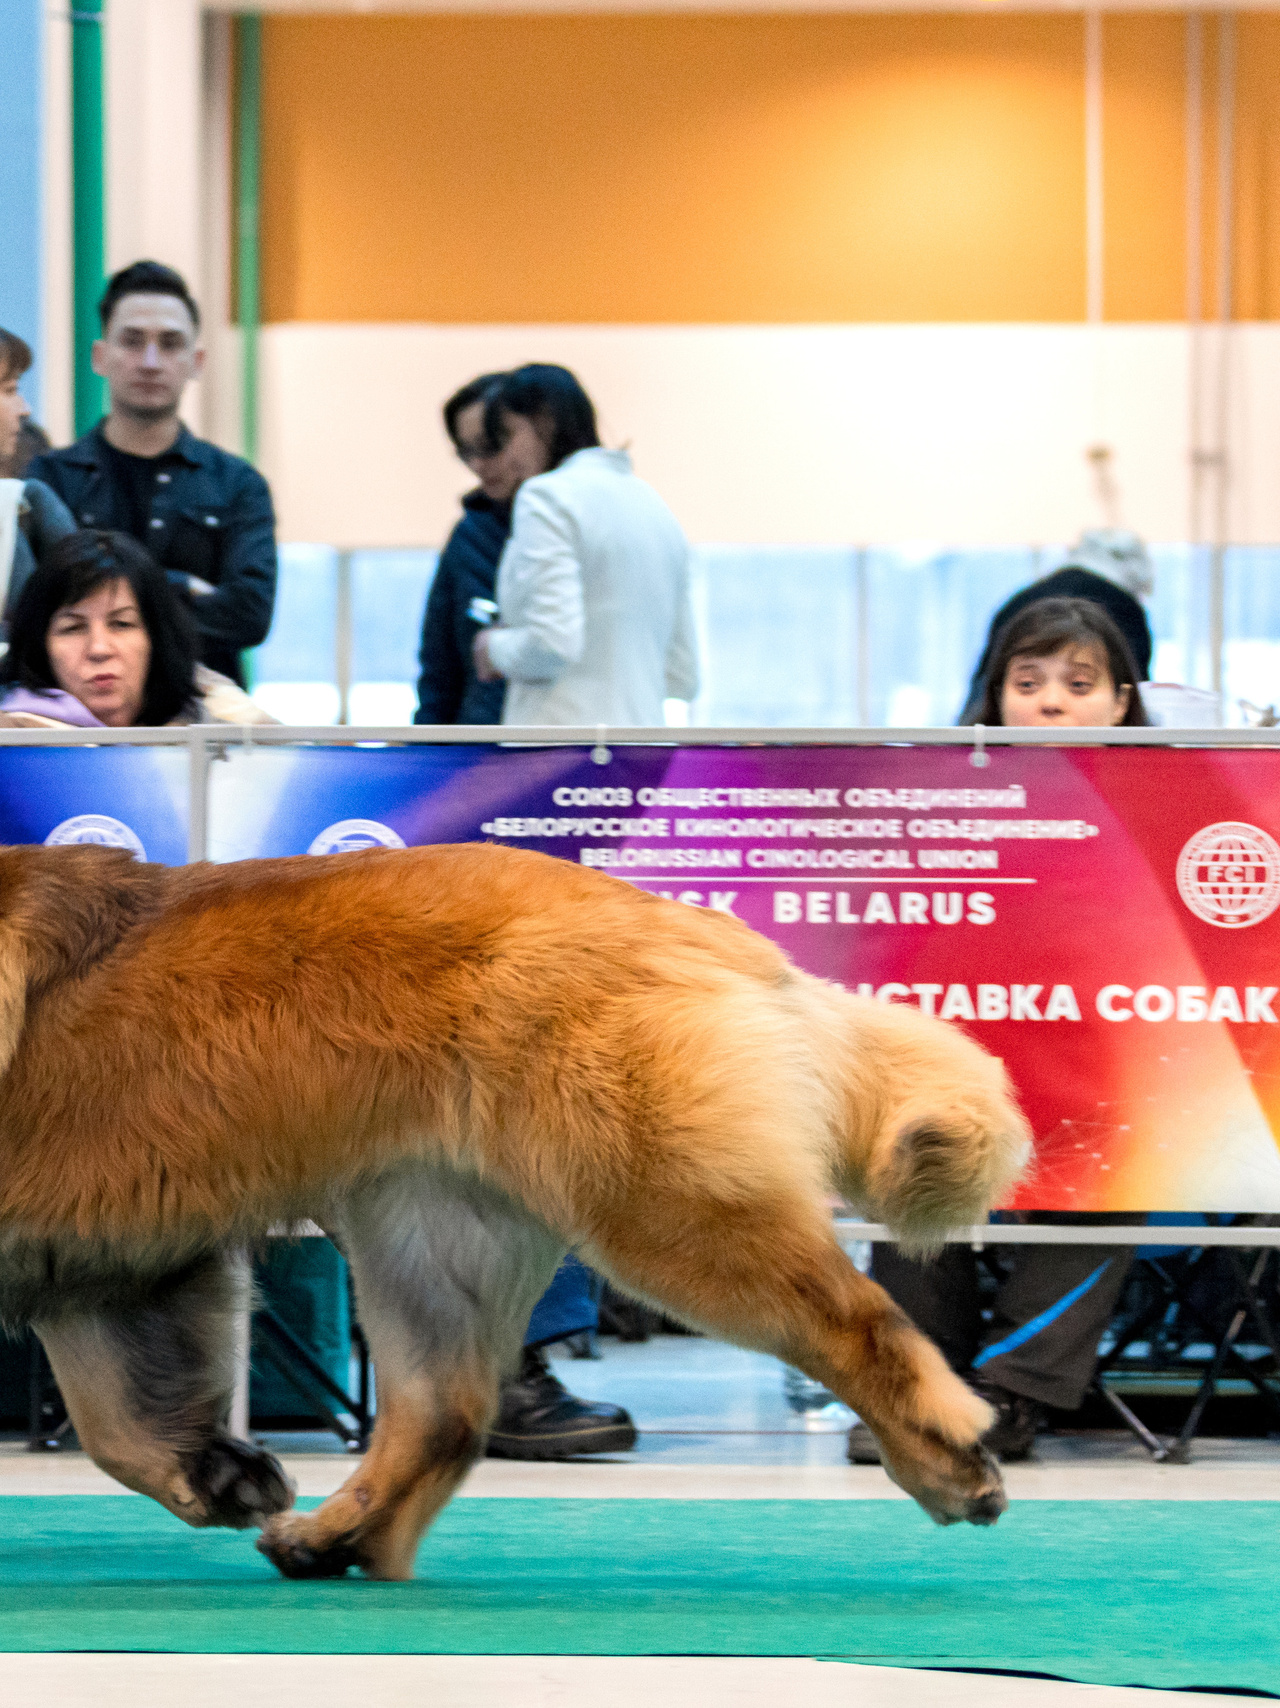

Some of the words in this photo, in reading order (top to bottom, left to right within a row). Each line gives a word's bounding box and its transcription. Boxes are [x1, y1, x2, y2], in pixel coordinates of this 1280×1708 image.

[553, 787, 633, 807] СОЮЗ
[636, 787, 841, 809] ОБЩЕСТВЕННЫХ
[844, 784, 1027, 810] ОБЪЕДИНЕНИЙ
[674, 817, 904, 838] КИНОЛОГИЧЕСКОЕ
[580, 848, 742, 868] BELORUSSIAN
[746, 849, 915, 869] CINOLOGICAL
[917, 849, 999, 870] UNION
[1207, 865, 1257, 883] FCI
[773, 890, 997, 925] BELARUS
[1095, 984, 1280, 1023] СОБАК
